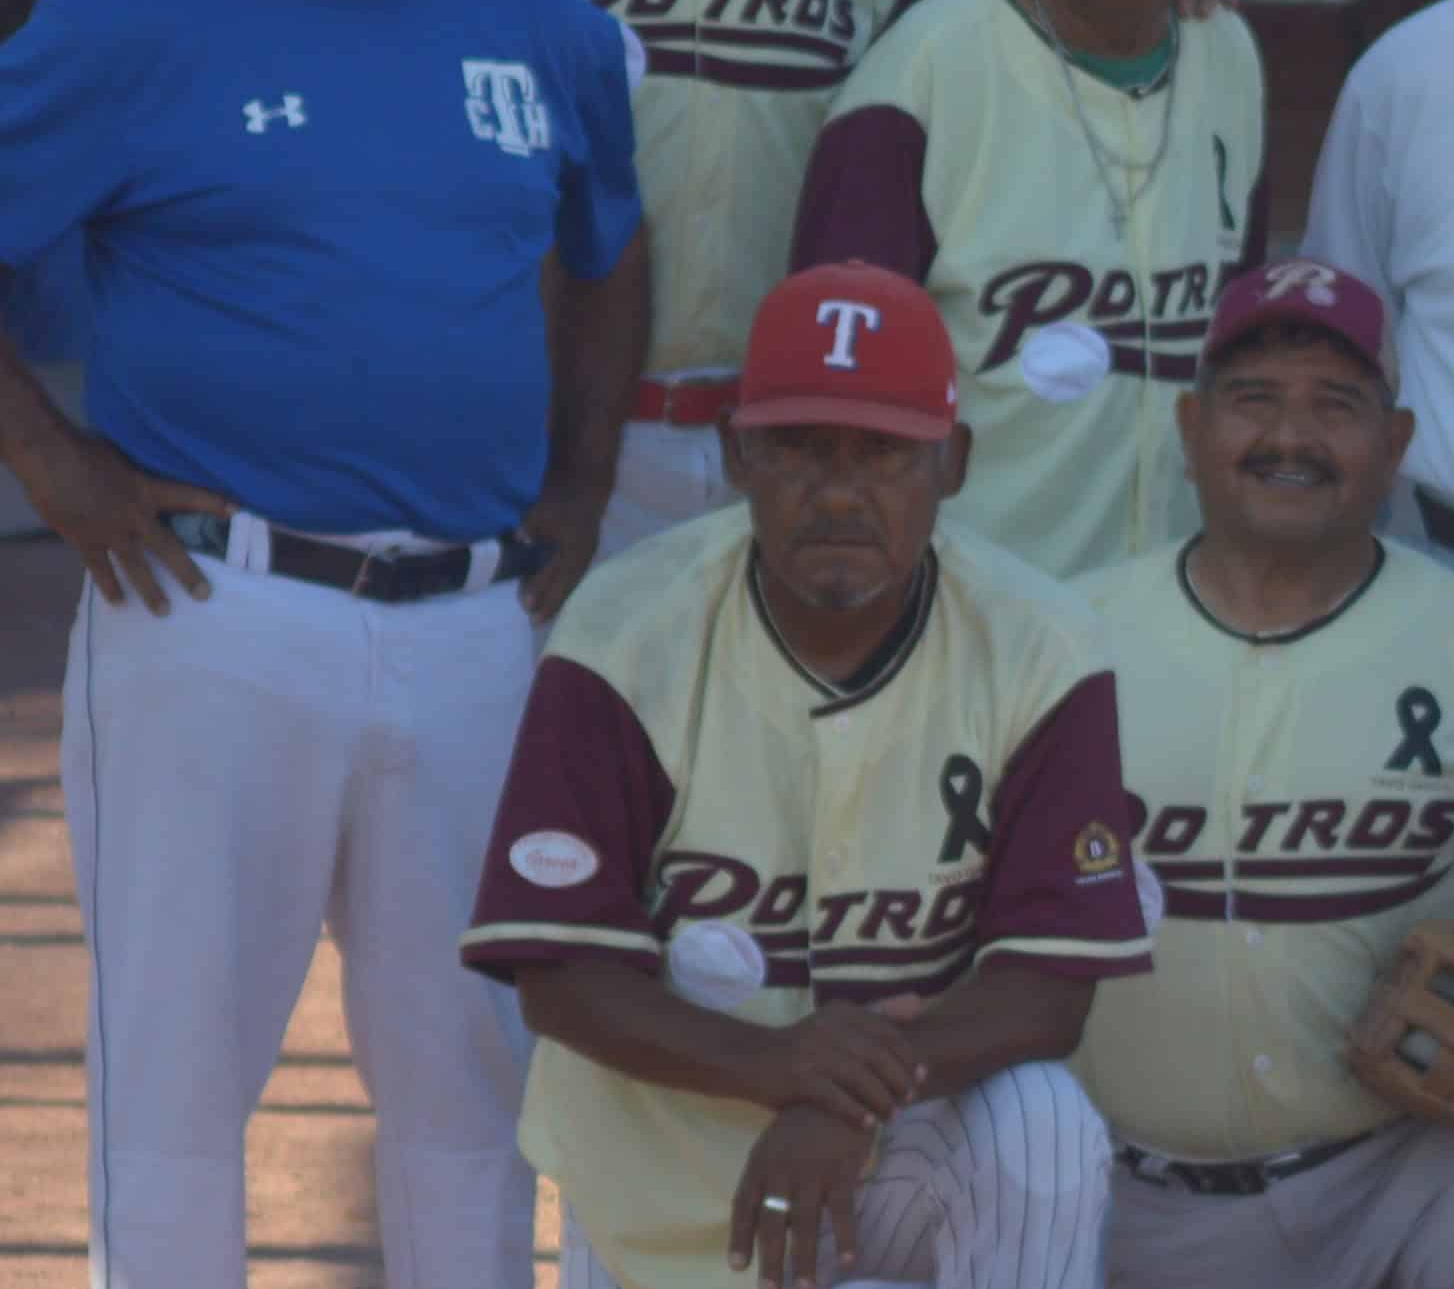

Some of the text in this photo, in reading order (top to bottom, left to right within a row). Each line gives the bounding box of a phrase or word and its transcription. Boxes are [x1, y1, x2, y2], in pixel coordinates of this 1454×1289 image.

[816, 299, 880, 371] T
[975, 260, 1228, 375] POTR
[653, 850, 988, 943] POTRO
